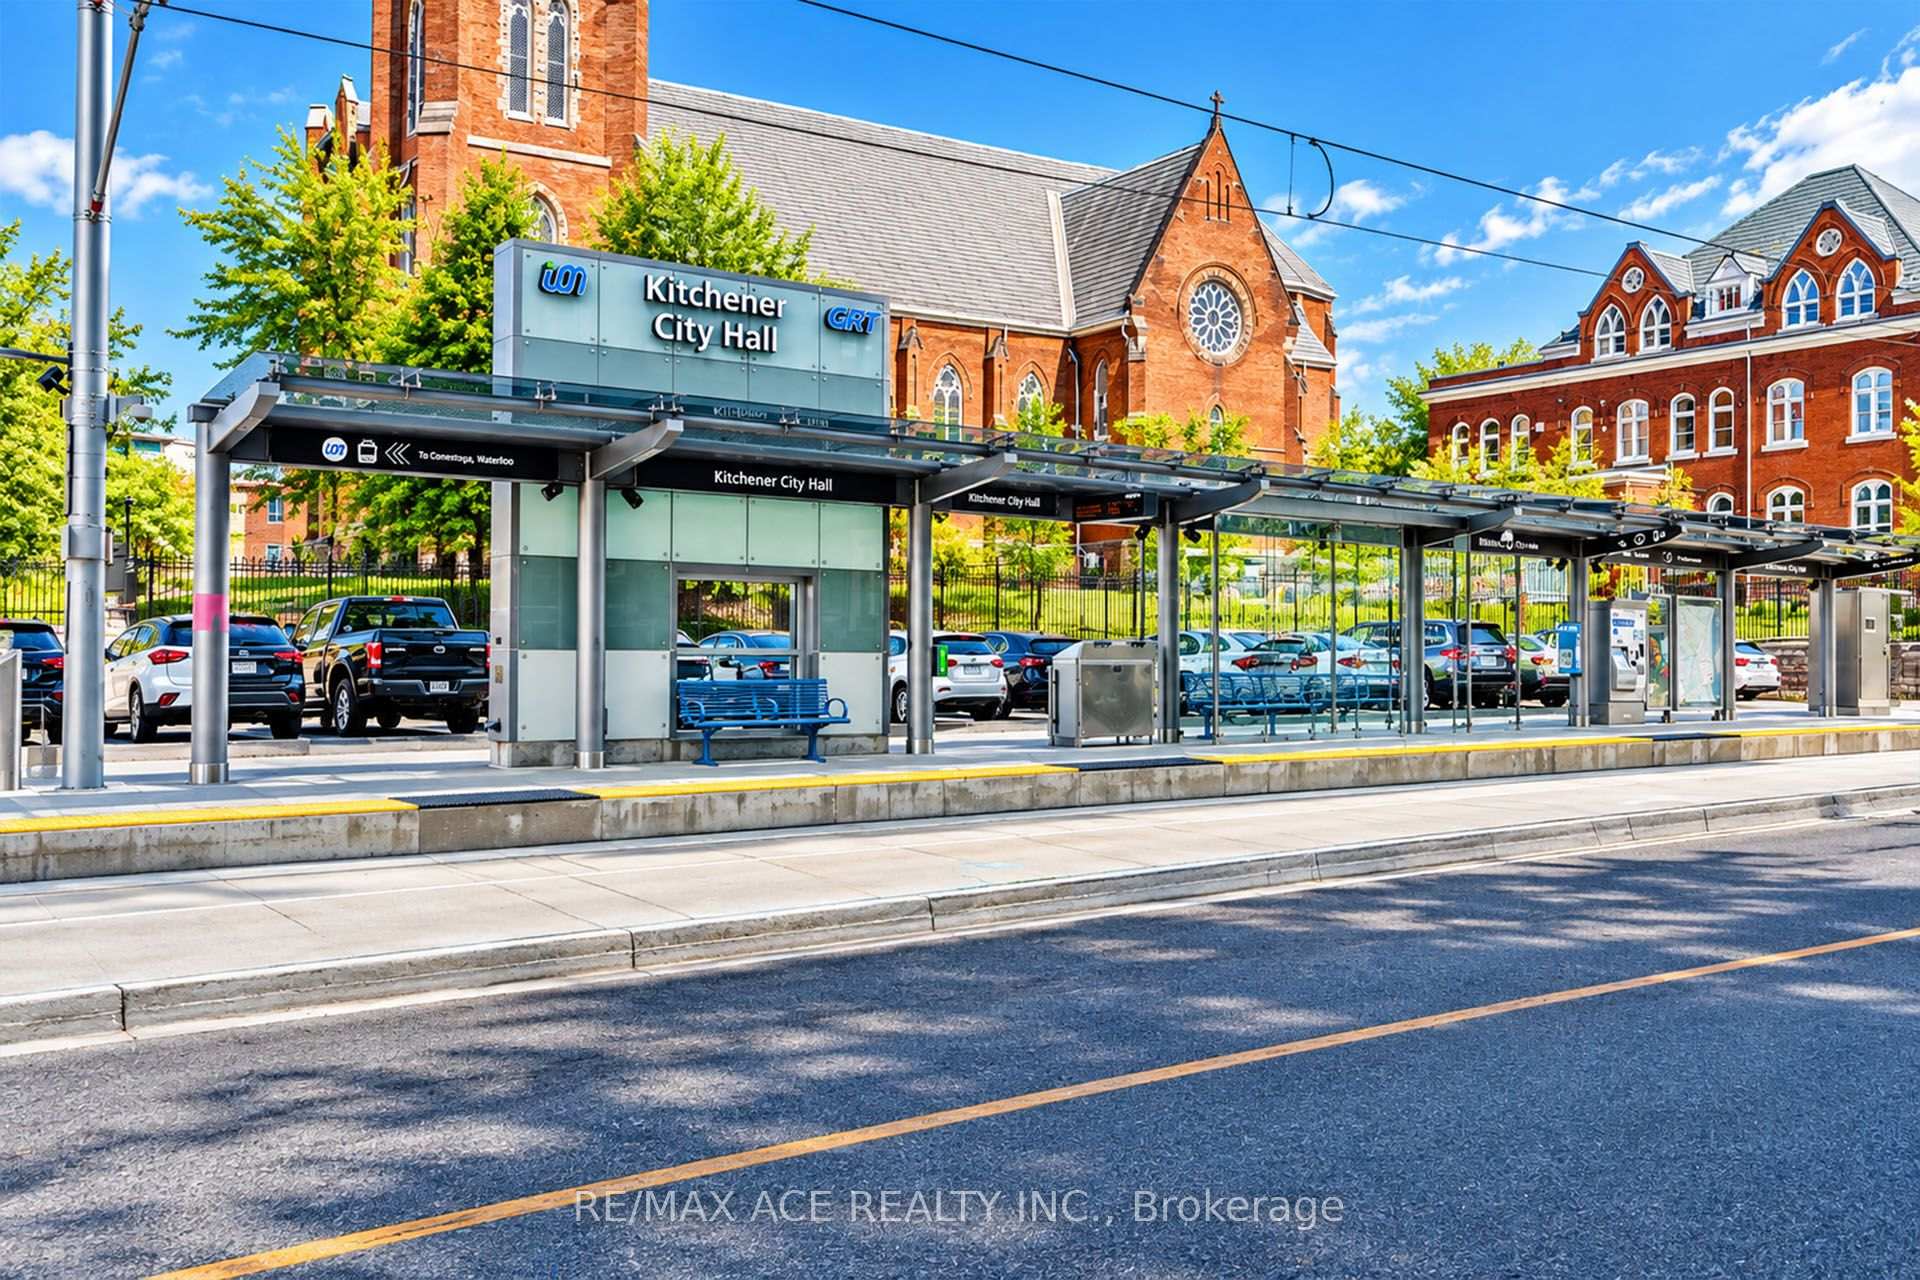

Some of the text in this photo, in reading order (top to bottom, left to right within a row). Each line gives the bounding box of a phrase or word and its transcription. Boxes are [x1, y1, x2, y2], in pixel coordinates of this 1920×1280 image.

[645, 274, 788, 318] Kitchener
[654, 312, 777, 352] City Hall
[827, 304, 882, 335] GRT
[418, 450, 515, 466] To Conestoga, Waterloo
[713, 469, 833, 493] Kitchener City Hall
[968, 492, 1041, 509] Kitchener City Hall
